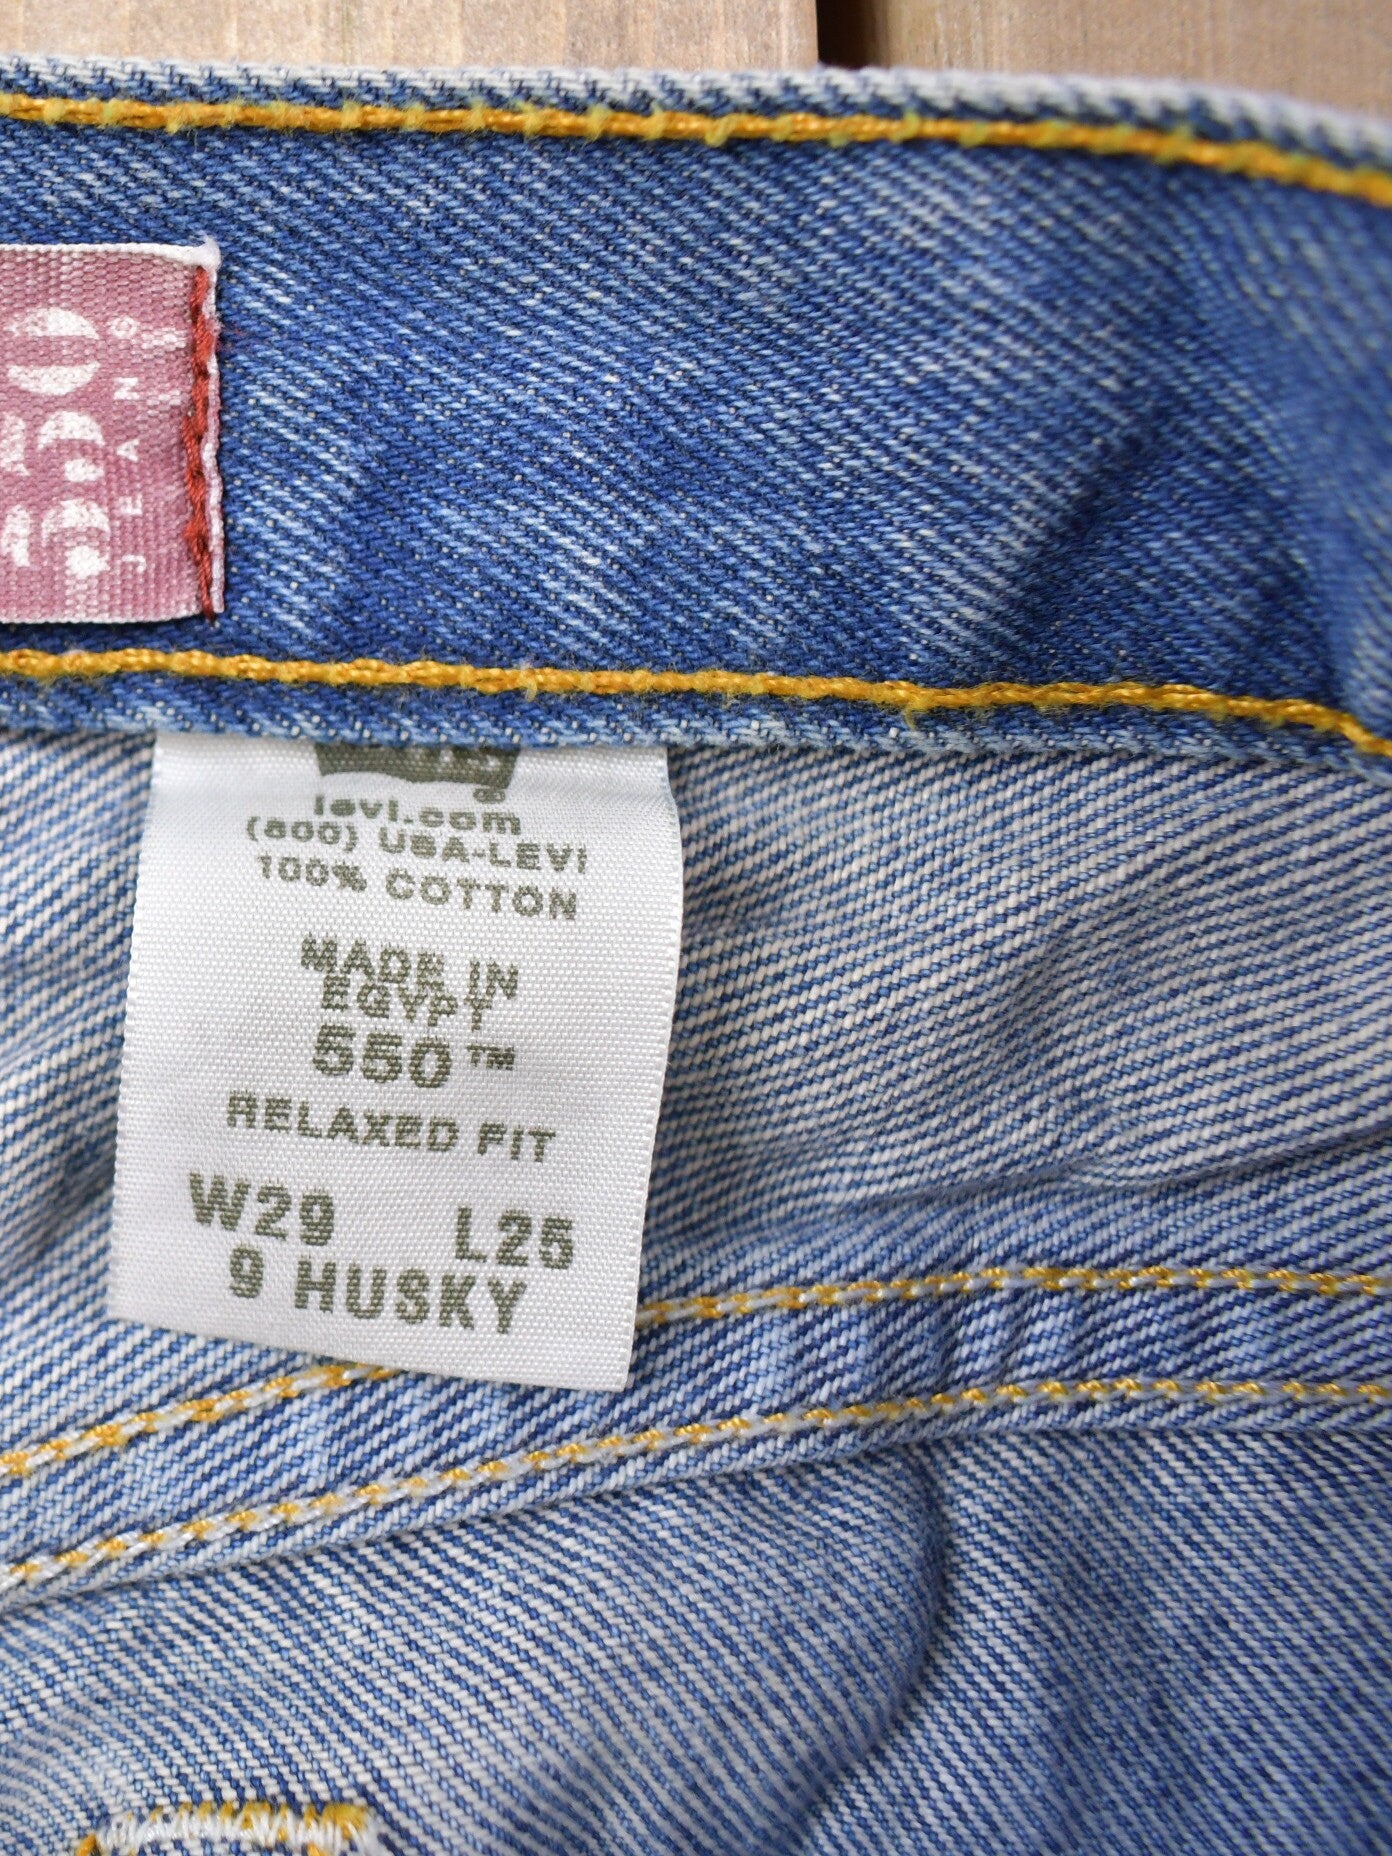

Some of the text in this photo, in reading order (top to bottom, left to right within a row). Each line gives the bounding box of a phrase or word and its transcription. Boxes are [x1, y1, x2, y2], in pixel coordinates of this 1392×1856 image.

[246, 815, 587, 874] (800) USA-LEVI
[314, 794, 520, 835] levi.com
[257, 852, 577, 920] 100% COTTON
[301, 932, 519, 1000] MADE IN
[321, 974, 495, 1031] EGYPT
[226, 1090, 557, 1163] RELAXED FIT
[190, 1172, 575, 1270] W29 L25
[229, 1243, 527, 1334] 9 HUSKY
